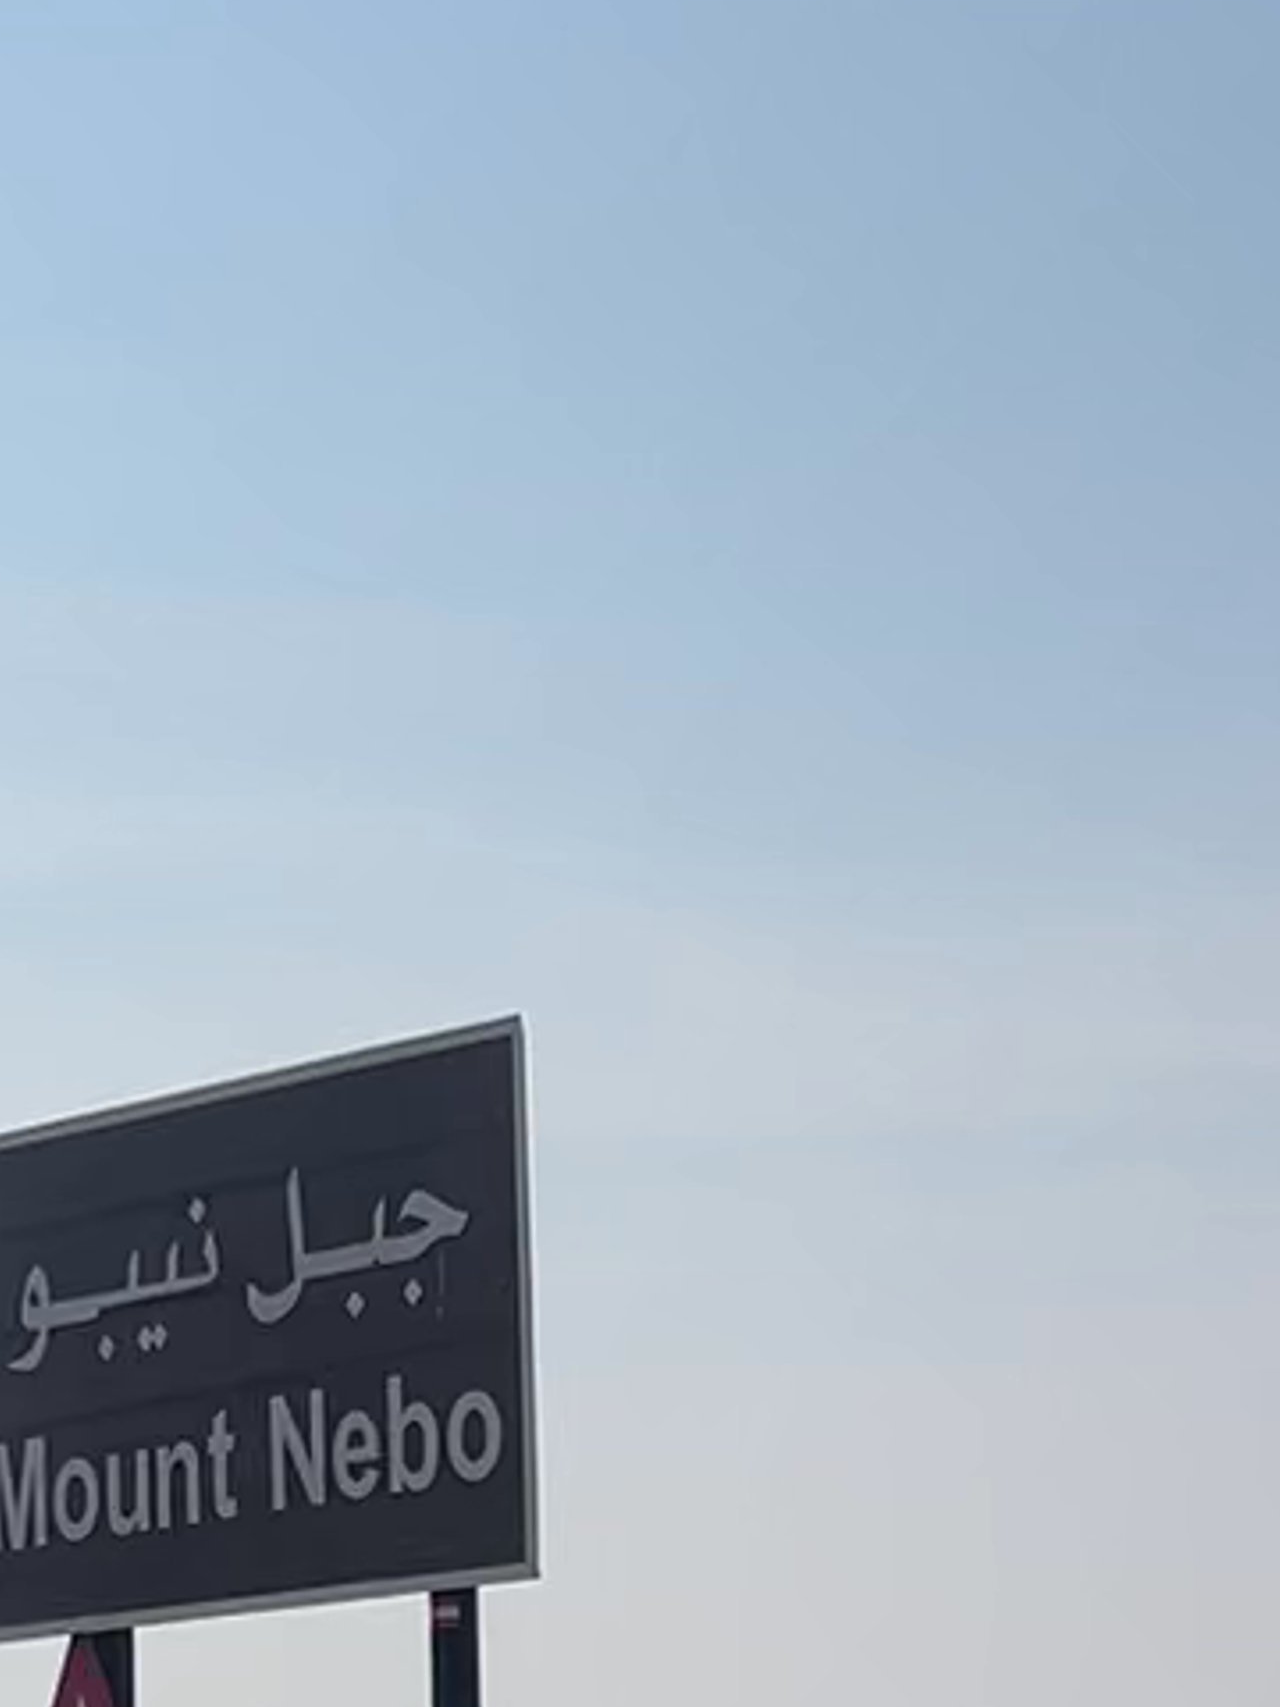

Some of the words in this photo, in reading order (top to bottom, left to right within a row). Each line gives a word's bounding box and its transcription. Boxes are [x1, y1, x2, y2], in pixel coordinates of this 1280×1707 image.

[6, 1197, 220, 1372] نيبو
[246, 1166, 470, 1325] جبل
[268, 1374, 504, 1512] Nebo
